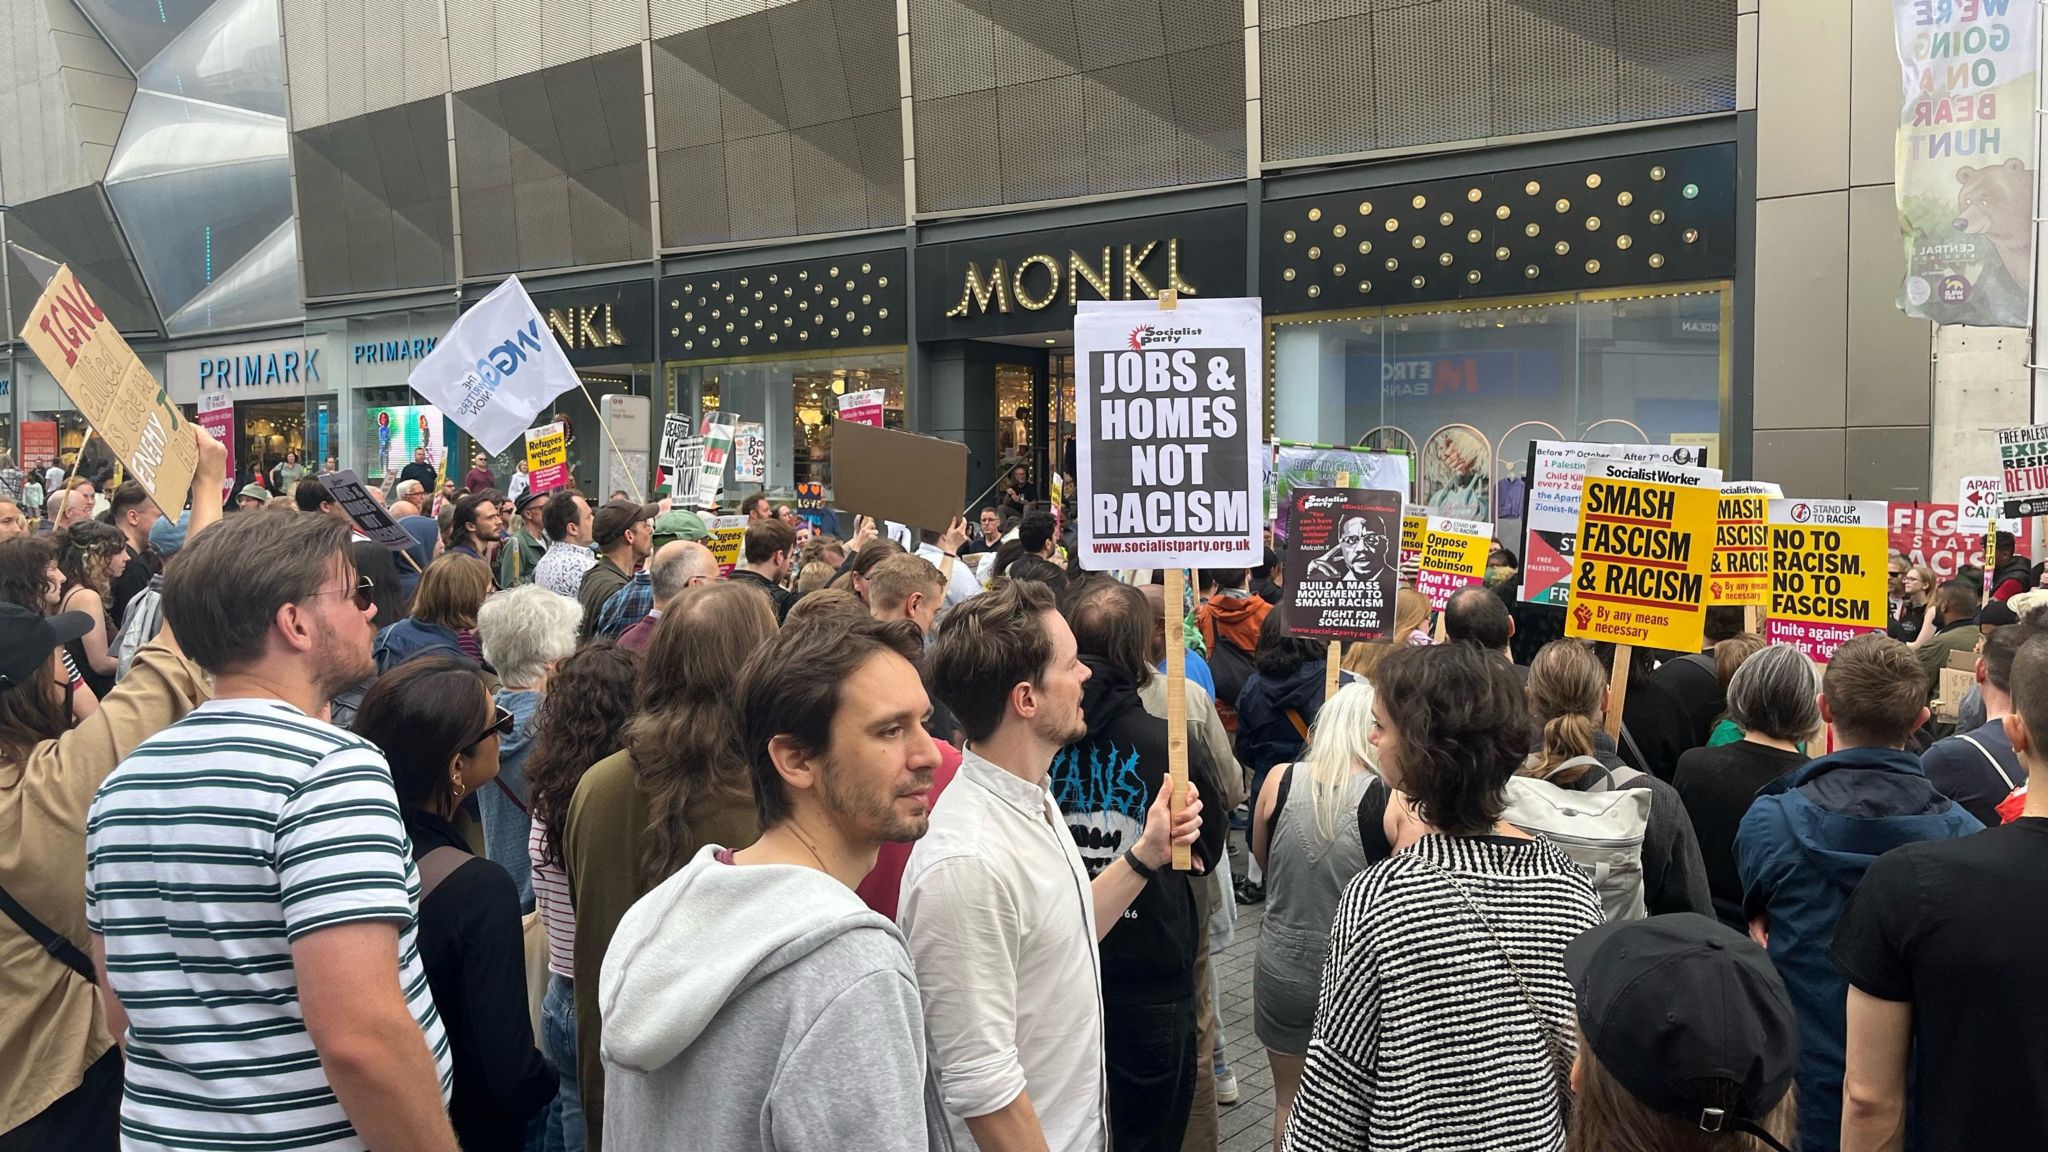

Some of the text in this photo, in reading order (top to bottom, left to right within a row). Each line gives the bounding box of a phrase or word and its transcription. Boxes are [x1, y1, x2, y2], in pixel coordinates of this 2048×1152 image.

[1145, 326, 1203, 337] Socialist
[354, 336, 437, 364] PRIMARK
[198, 349, 320, 389] PRIMARK
[1100, 350, 1236, 393] JOBS &
[1100, 396, 1237, 440] HOMES
[529, 435, 562, 451] Refugees
[1999, 430, 2019, 444] FREE
[131, 411, 168, 494] ENEMY
[531, 445, 562, 460] welcome
[1565, 449, 1576, 457] 7th
[1624, 453, 1698, 463] After 7th Ocer
[539, 457, 556, 467] here
[1131, 444, 1208, 486] NOT
[1551, 460, 1585, 469] Palestin
[1546, 472, 1583, 481] Child Kill
[1537, 481, 1562, 490] every
[1966, 480, 2000, 490] APART
[797, 497, 822, 510] LOVE
[1308, 495, 1348, 503] Socialist
[1586, 483, 1675, 520] SMASH
[1093, 490, 1248, 535] RACISM
[1535, 503, 1578, 515] Zionist-Re
[1717, 499, 1763, 520] MASH
[1812, 505, 1856, 514] STAND UP
[1403, 521, 1419, 529] ose
[1813, 514, 1861, 524] TO RACISM
[1893, 508, 1957, 536] FIG
[714, 531, 742, 543] fugees
[1428, 533, 1468, 549] Oppose
[1582, 522, 1691, 562] FASCISM
[1716, 525, 1768, 546] ASCIS
[1773, 529, 1841, 551] NO TO
[1913, 535, 1975, 549] STAT
[708, 542, 738, 553] elcome
[1093, 538, 1250, 554] www.socialistparty.org.uk
[1426, 545, 1464, 561] Tommy
[1423, 557, 1473, 573] Robinson
[1536, 556, 1552, 564] FREE
[1710, 552, 1721, 572] &
[1773, 551, 1866, 578] RACISM,
[1888, 548, 1985, 576] ACIS
[1527, 564, 1560, 573] PALESTINE
[1299, 581, 1380, 590] BUILD A MASS
[1420, 571, 1468, 587] Don't let
[1577, 561, 1703, 603] & RACISM
[1773, 573, 1841, 595] NO TO
[1418, 583, 1436, 596] the
[1550, 586, 1569, 600] FR
[1725, 581, 1734, 591] By
[1736, 583, 1749, 592] any
[1297, 590, 1382, 599] MOVEMENT TO
[1725, 592, 1760, 600] necessary
[1295, 598, 1383, 608] SMASH RACISM
[1772, 594, 1869, 620] FASCISM
[1322, 610, 1377, 619] FIGHT FOR
[1597, 606, 1669, 627] By any means
[1318, 619, 1380, 628] SOCIALISM!
[1595, 622, 1649, 640] necessary
[1771, 622, 1854, 642] Unite against
[1795, 639, 1813, 653] far
